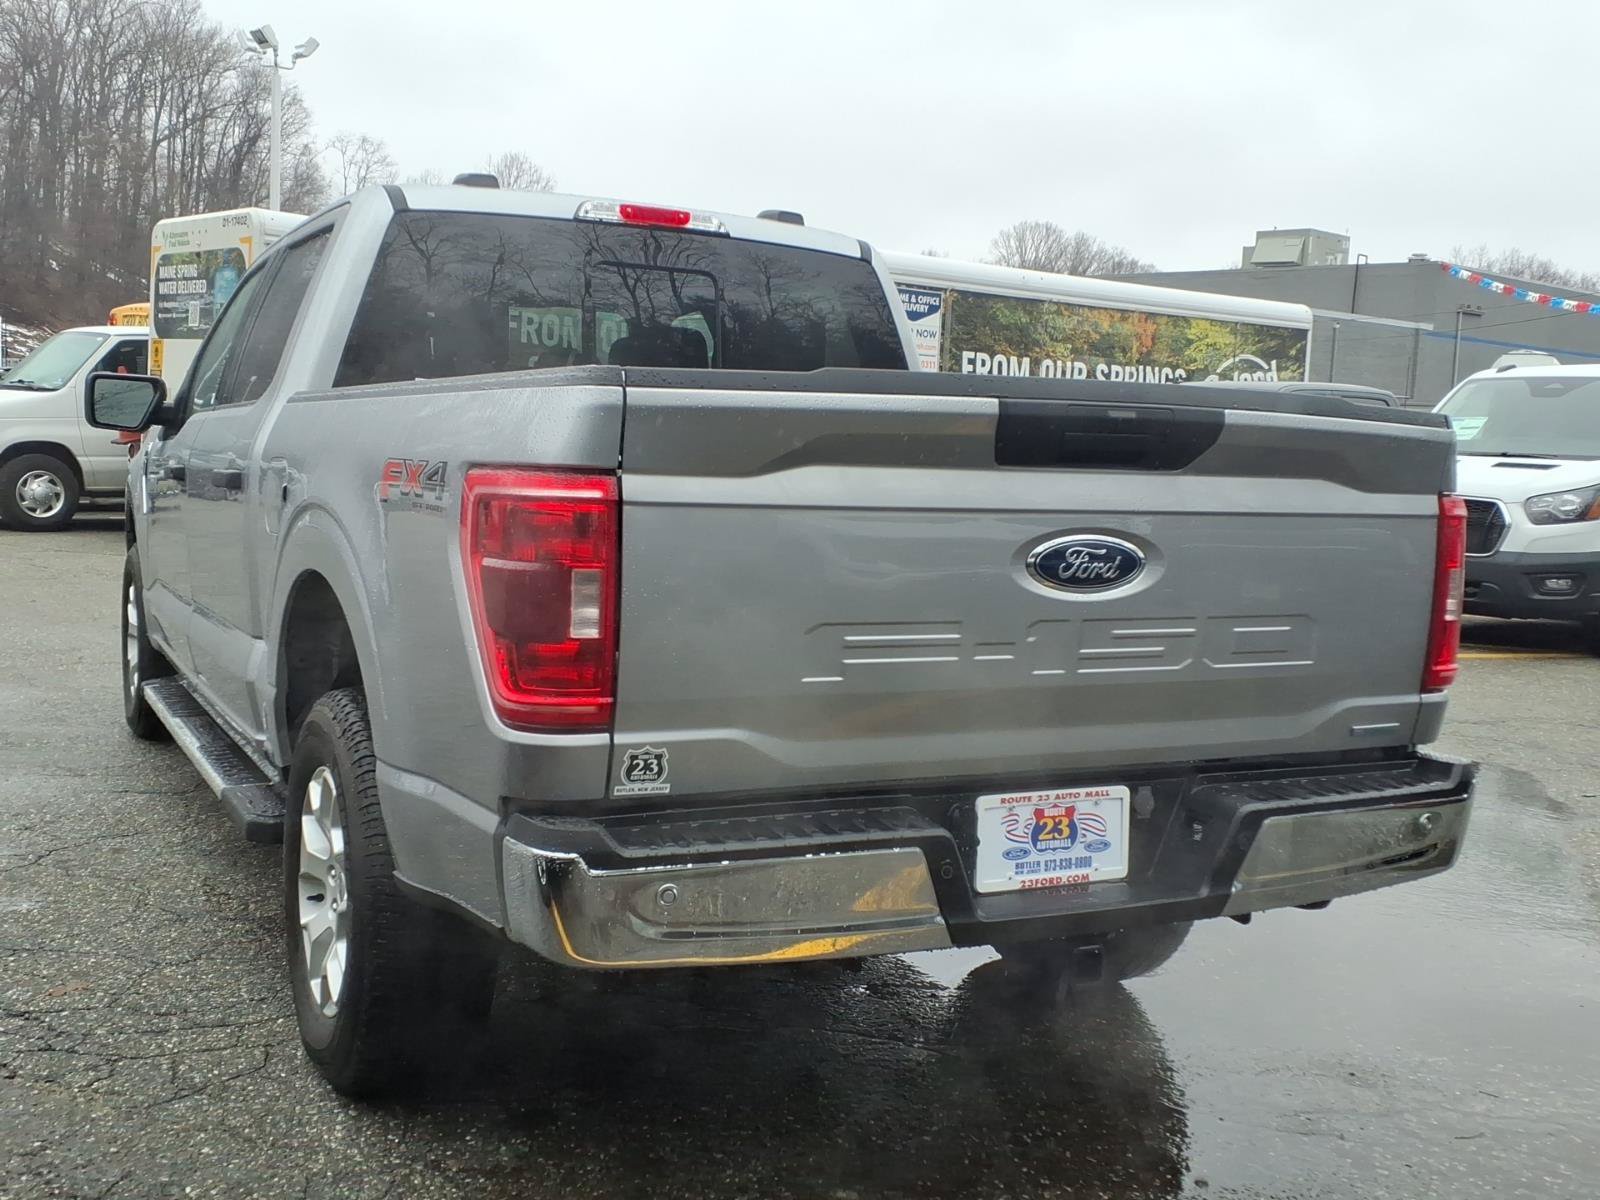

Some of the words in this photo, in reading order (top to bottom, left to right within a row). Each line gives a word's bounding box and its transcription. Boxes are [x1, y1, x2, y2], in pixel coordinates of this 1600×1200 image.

[159, 265, 177, 279] MAINE
[177, 263, 198, 279] SPRING
[158, 281, 177, 295] WATER
[177, 279, 207, 294] DELIVERED
[904, 303, 929, 313] ELIVERY
[918, 296, 940, 305] OFFICE
[916, 328, 937, 338] NOW
[962, 350, 1030, 377] FROM
[379, 457, 448, 502] FX4
[1058, 547, 1122, 579] Ford
[800, 612, 1315, 684] F-150
[631, 759, 659, 775] 23
[1000, 795, 1033, 805] ROUTE
[1037, 794, 1051, 803] 23
[1054, 791, 1081, 801] AUTO
[1085, 789, 1110, 798] MALL
[1038, 816, 1071, 841] 23
[1015, 860, 1041, 870] BUTLER
[1020, 873, 1090, 889] 23FORD.COM
